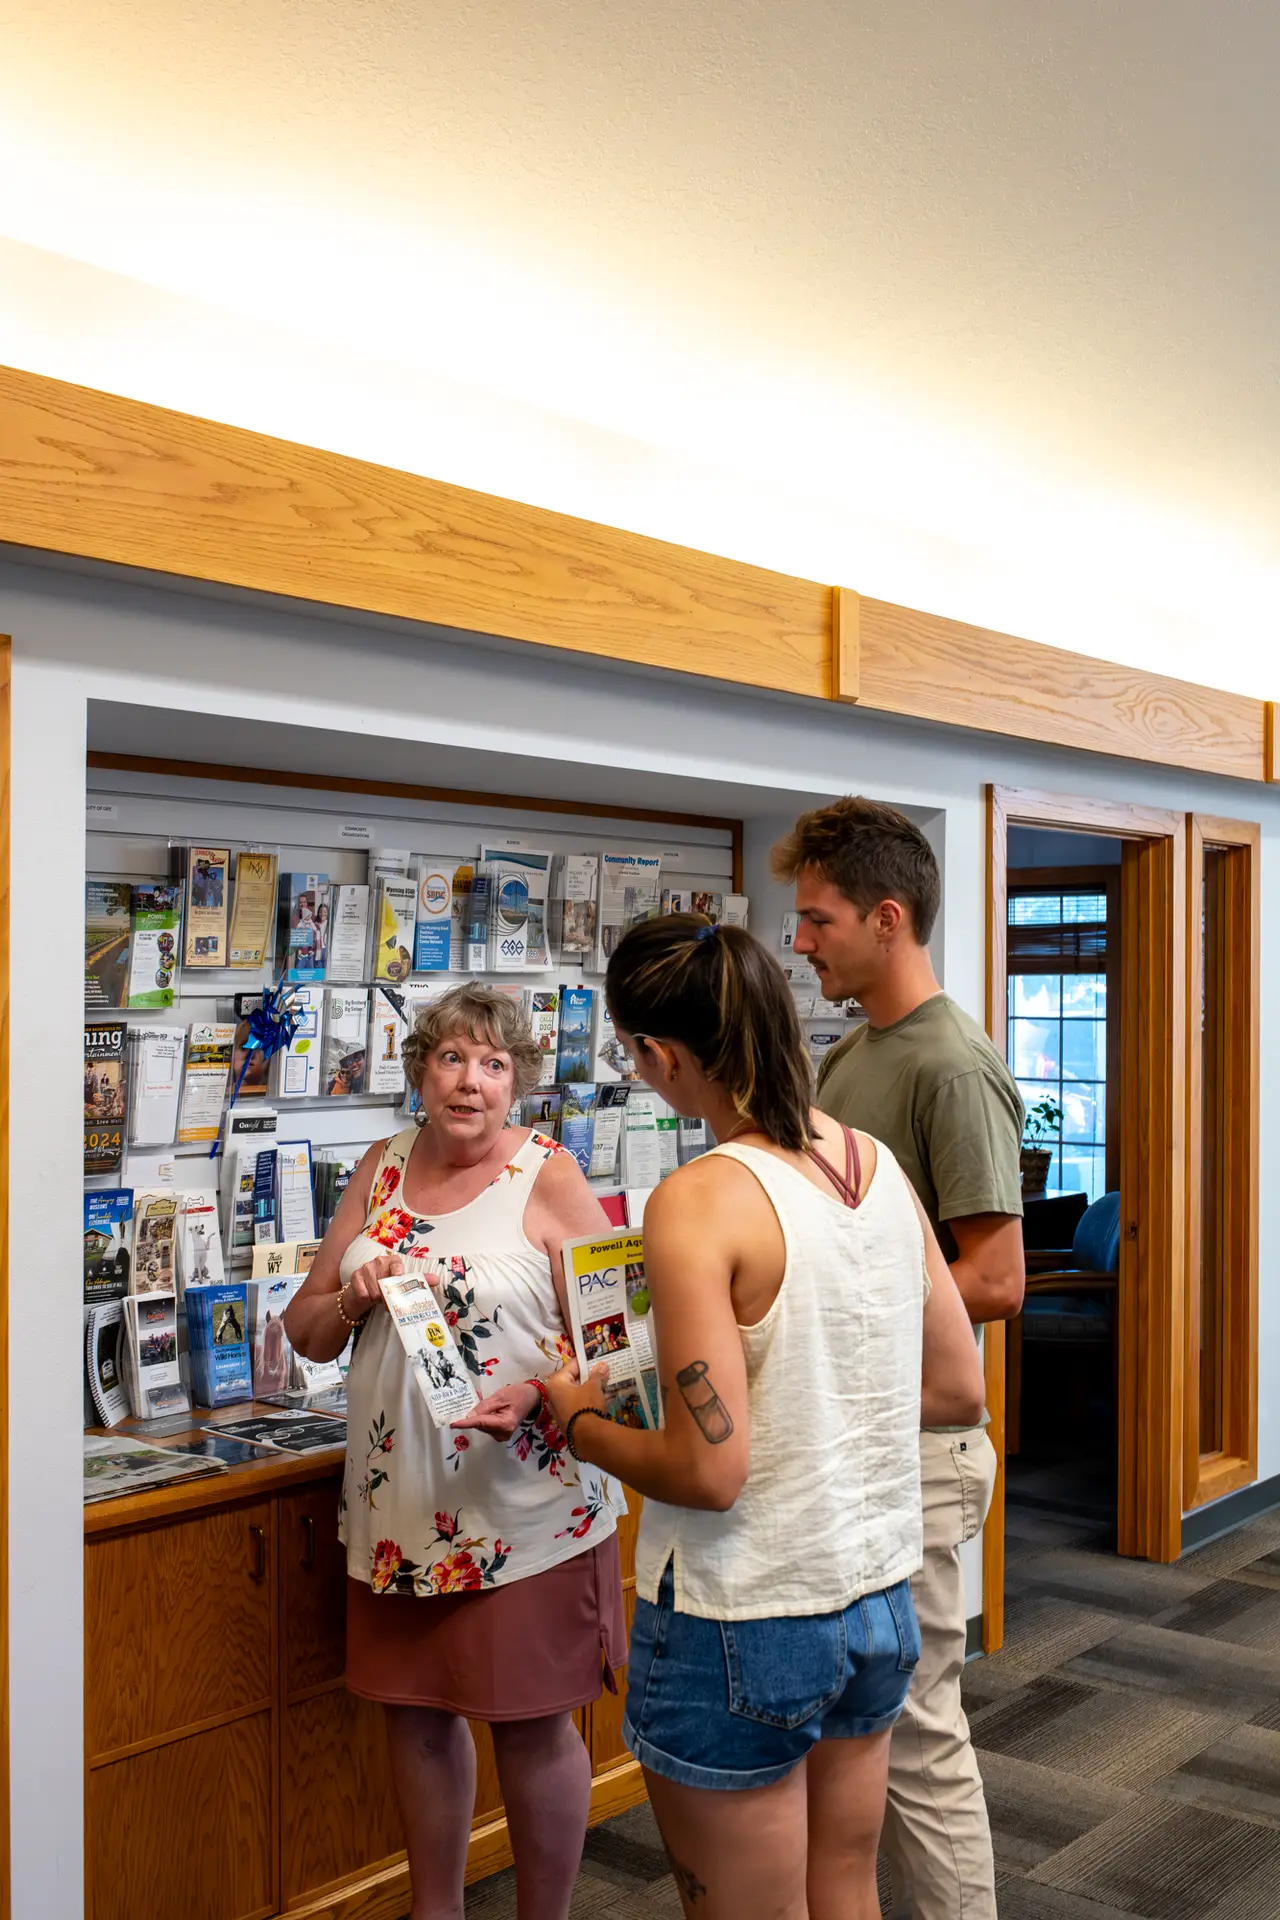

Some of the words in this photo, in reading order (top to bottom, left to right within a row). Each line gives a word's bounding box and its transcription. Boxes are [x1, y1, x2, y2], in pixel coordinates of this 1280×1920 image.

[604, 854, 636, 866] Community
[637, 857, 659, 867] Report
[426, 890, 445, 899] SBDC
[590, 1240, 623, 1255] Powell
[267, 1260, 283, 1274] WY
[578, 1267, 618, 1295] PAC
[398, 1310, 439, 1324] MUSEUM
[427, 1327, 441, 1338] FUN
